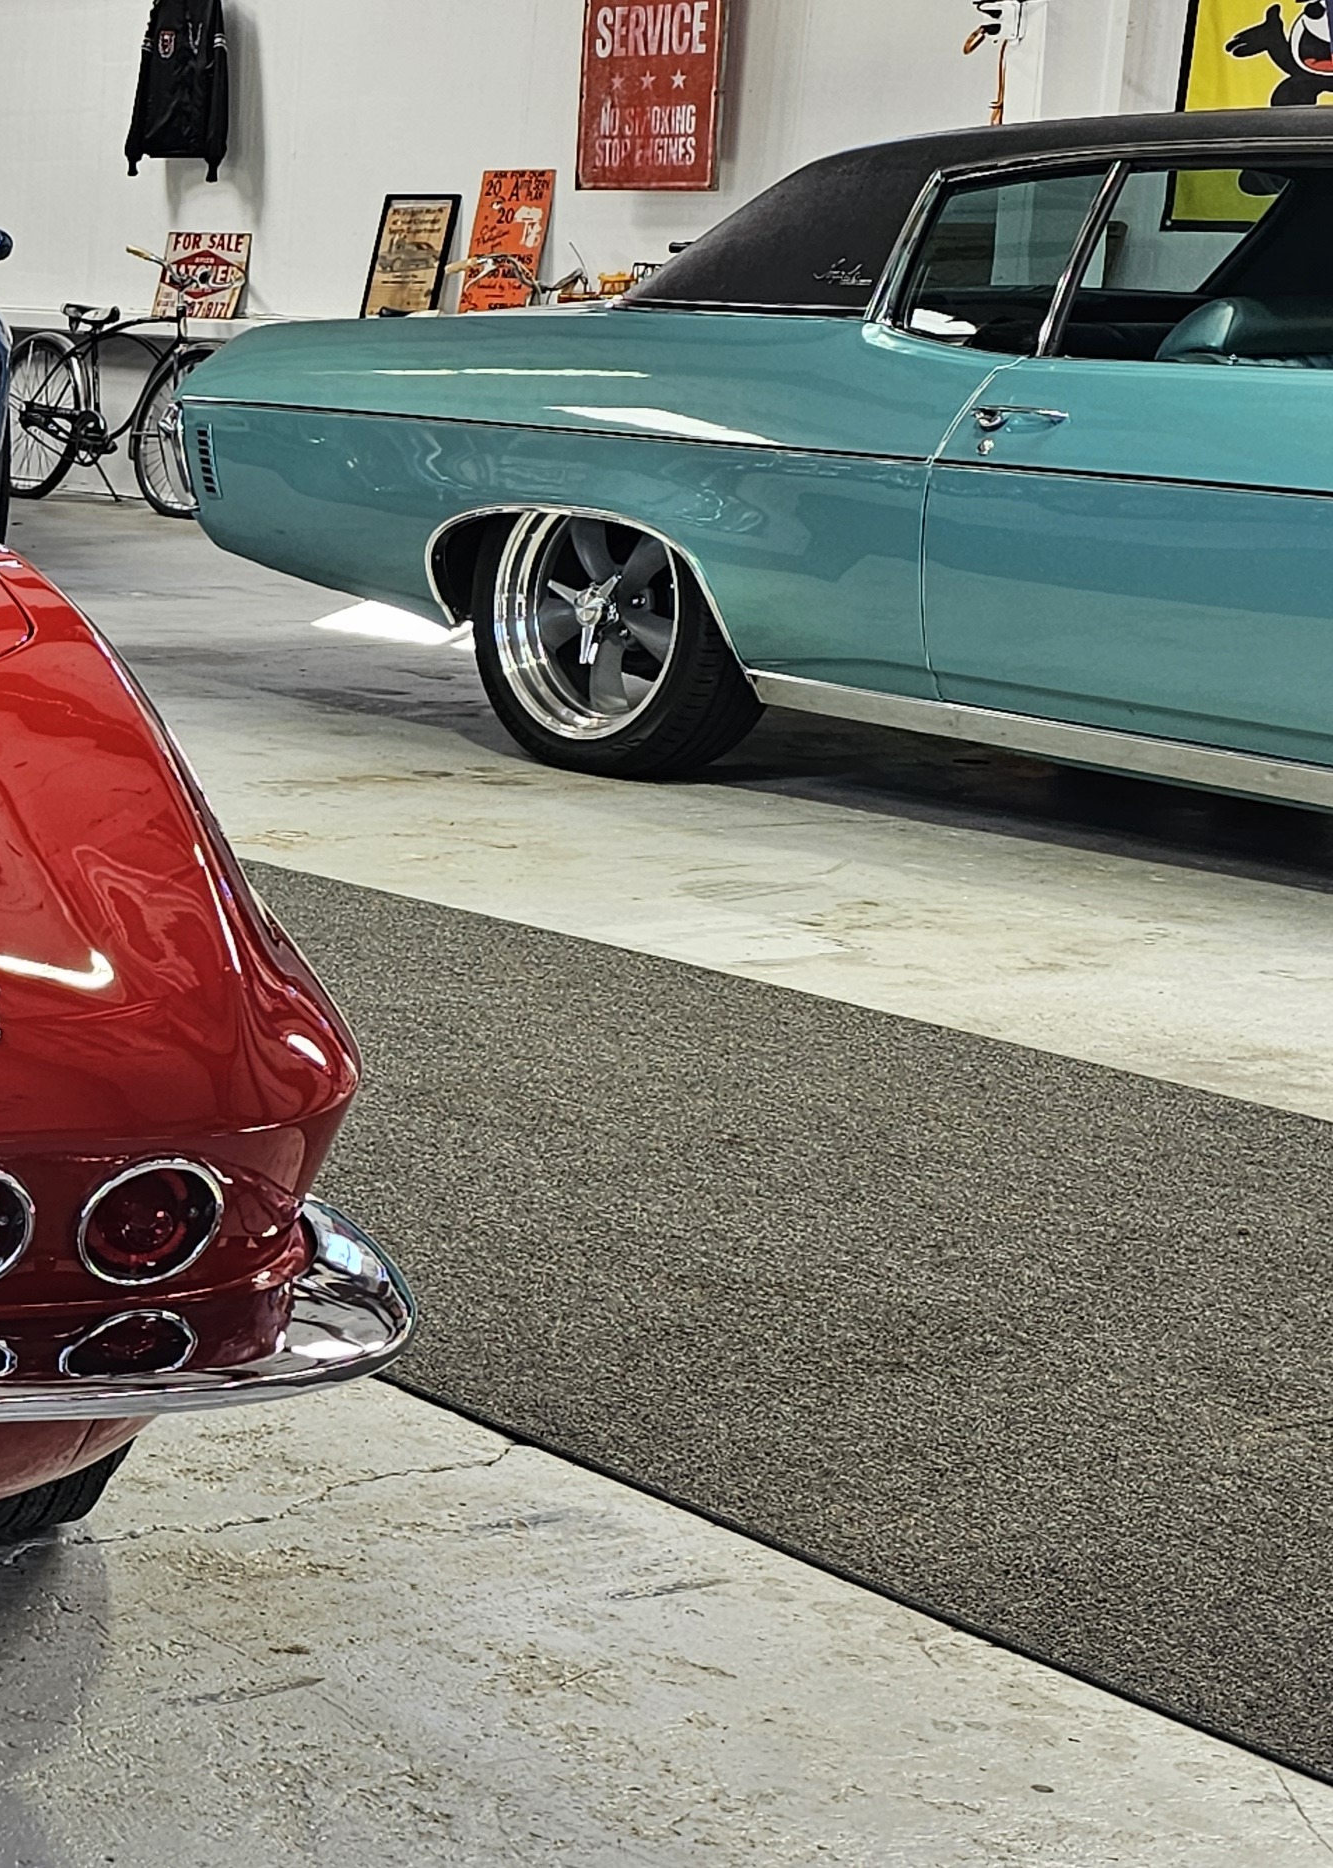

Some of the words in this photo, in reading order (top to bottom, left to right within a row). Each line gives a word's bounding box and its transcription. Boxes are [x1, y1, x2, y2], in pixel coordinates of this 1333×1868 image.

[595, 1, 709, 58] SERVICE
[600, 102, 620, 136] NO
[595, 138, 630, 167] STOP
[635, 137, 696, 167] ENGINES
[173, 233, 202, 252] FOR
[208, 233, 245, 253] SALE
